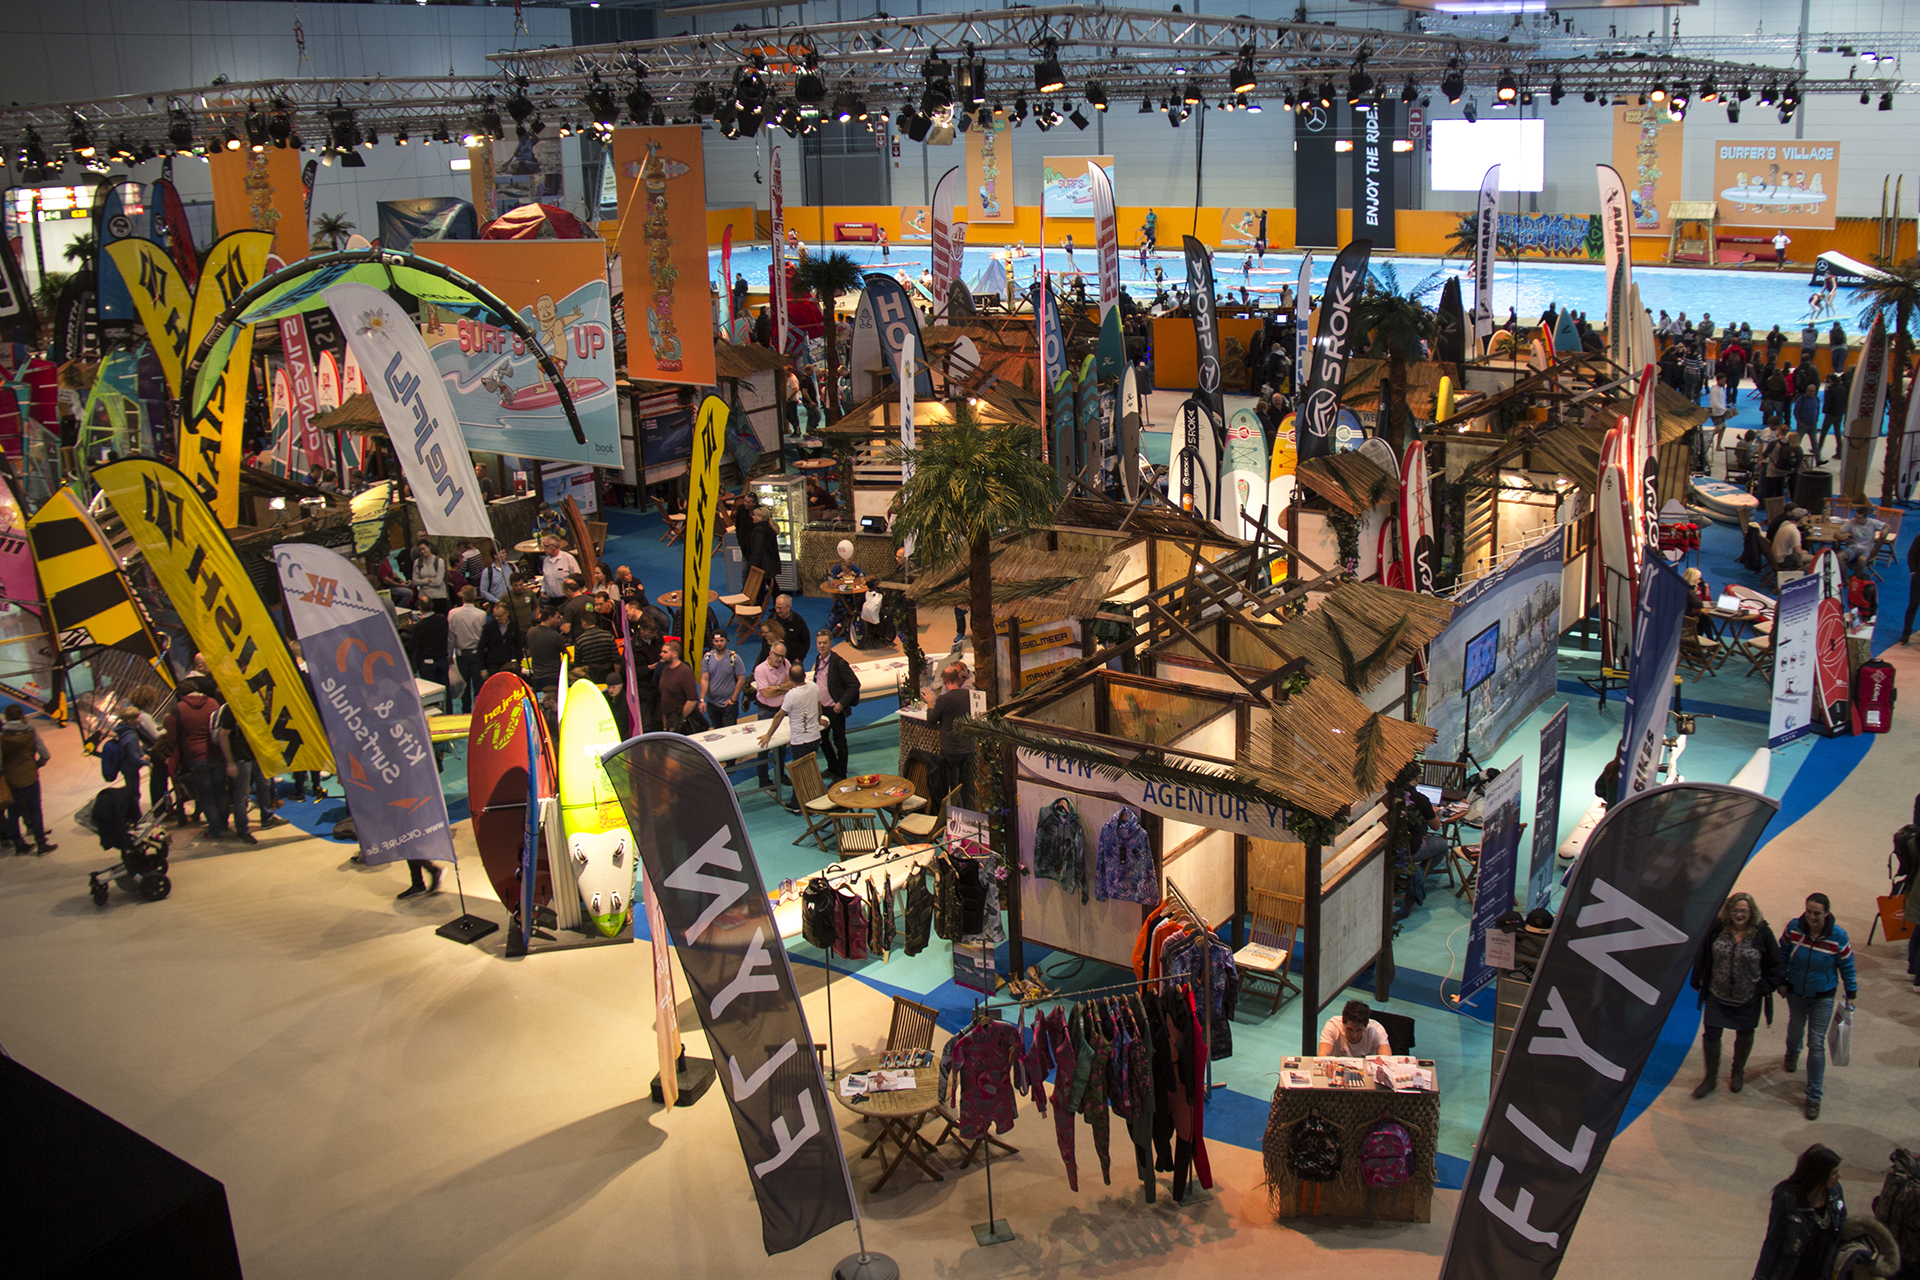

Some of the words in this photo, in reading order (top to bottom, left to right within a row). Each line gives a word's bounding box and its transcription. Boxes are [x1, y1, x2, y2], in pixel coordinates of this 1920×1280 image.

[1366, 147, 1380, 173] THE
[1720, 146, 1777, 160] SURFER'S
[1782, 147, 1835, 161] VILLAGE
[1058, 178, 1084, 190] SURF'S
[1366, 177, 1380, 226] ENJOY
[1479, 207, 1492, 290] INDIANA
[574, 323, 605, 360] UP
[1322, 265, 1357, 386] SROKA
[1187, 409, 1199, 445] SROKA
[595, 442, 615, 454] boot
[1183, 456, 1191, 478] SROKA
[1781, 578, 1818, 596] SCHILLER
[483, 686, 525, 724] hejfly
[1633, 728, 1655, 794] BIKES
[1142, 780, 1250, 823] AGENTUR
[1478, 876, 1690, 1250] FLYN
